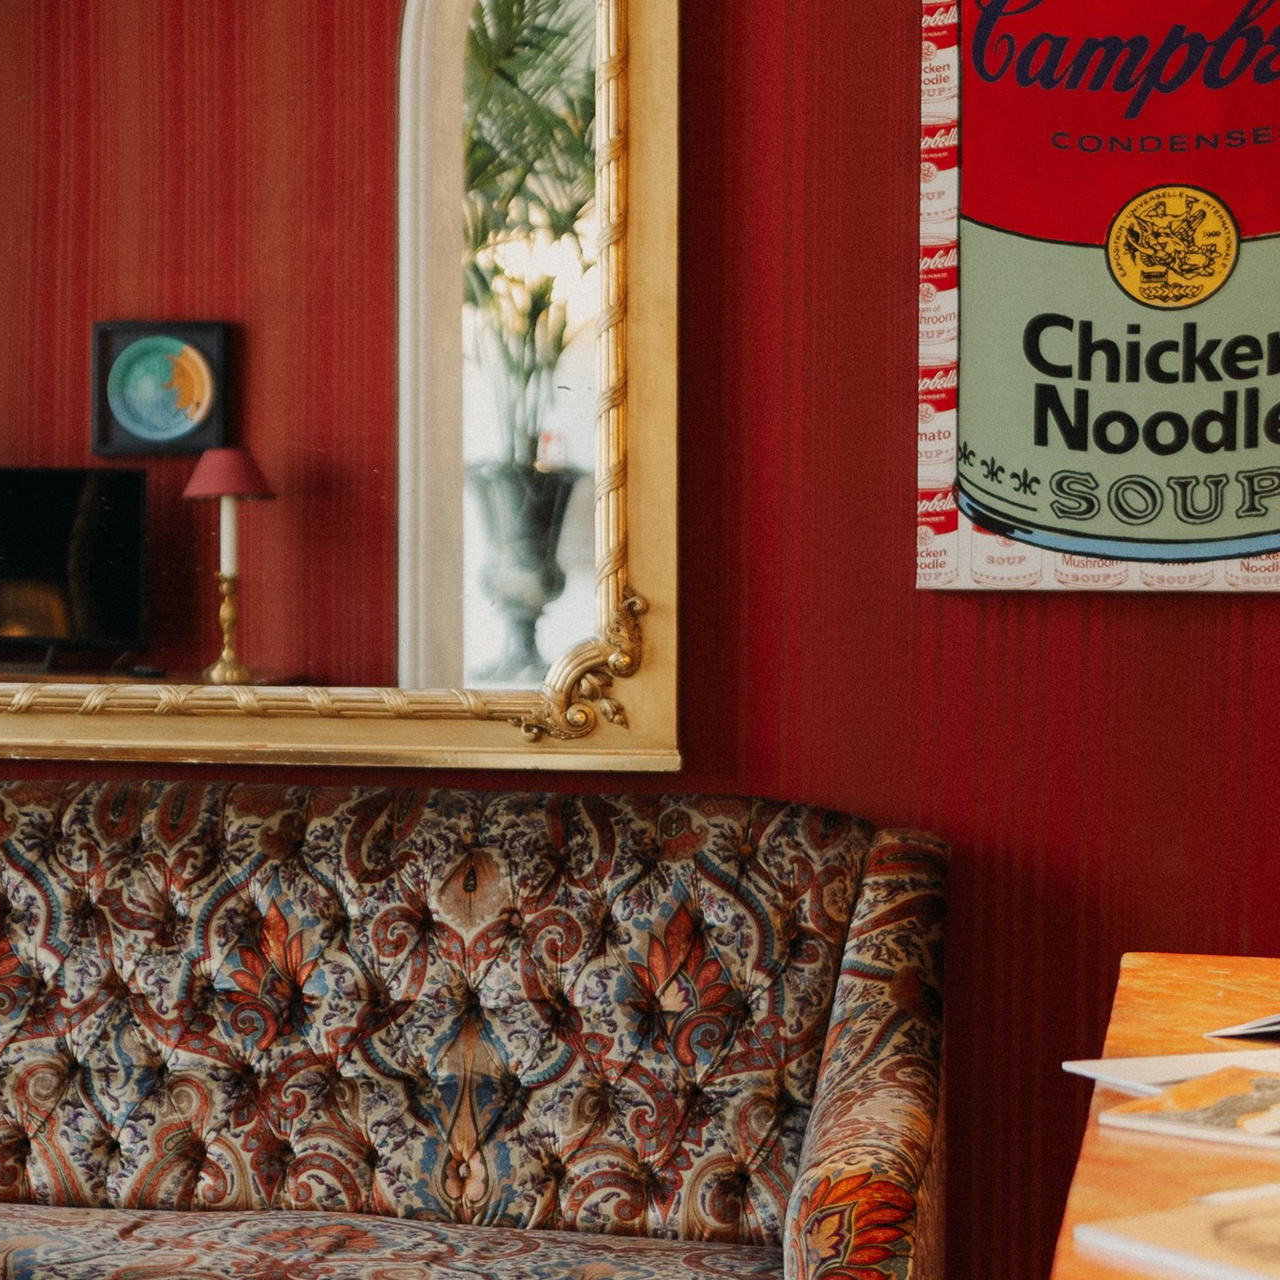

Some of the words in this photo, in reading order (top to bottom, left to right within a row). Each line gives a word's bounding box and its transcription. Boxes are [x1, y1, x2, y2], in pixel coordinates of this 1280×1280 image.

[1051, 125, 1280, 153] CONDENSE
[1049, 465, 1280, 526] SOUP
[986, 555, 1026, 565] SOUP
[1240, 561, 1280, 572] Noodl
